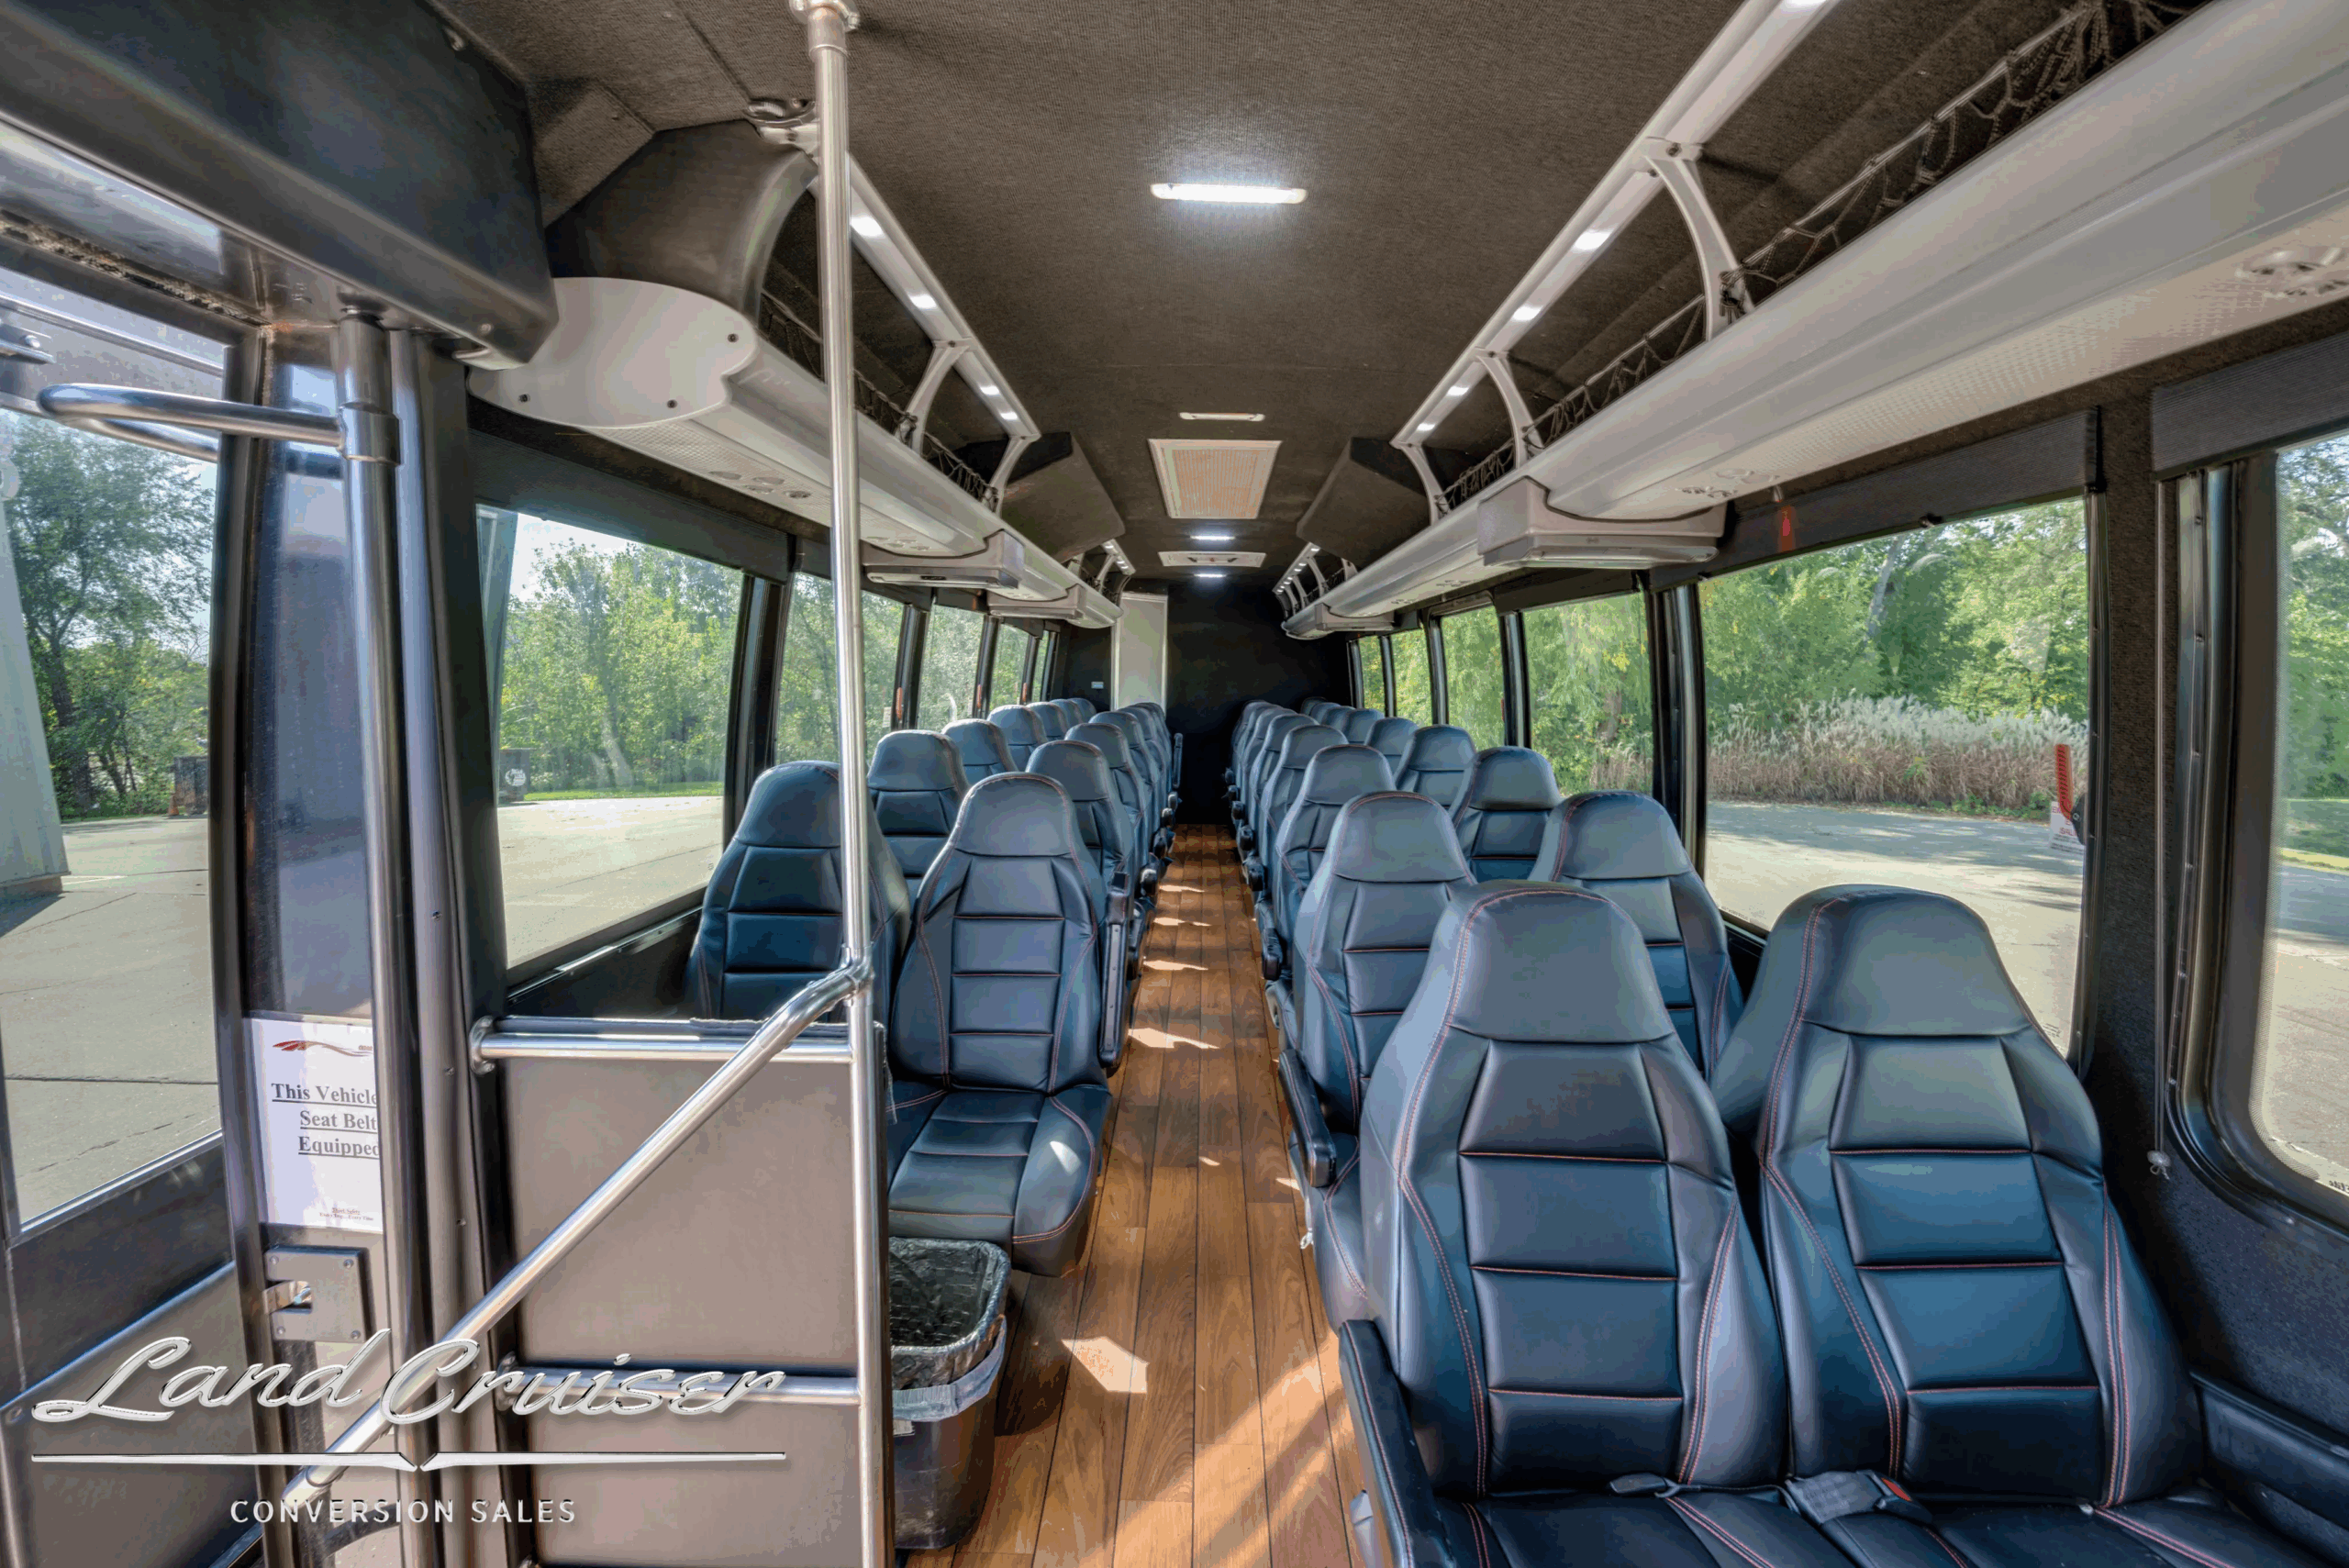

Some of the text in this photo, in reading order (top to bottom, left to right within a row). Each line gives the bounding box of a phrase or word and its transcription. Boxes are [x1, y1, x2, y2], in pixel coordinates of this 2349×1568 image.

[271, 1083, 377, 1105] This Vehicle
[300, 1109, 376, 1130] Seat Belt
